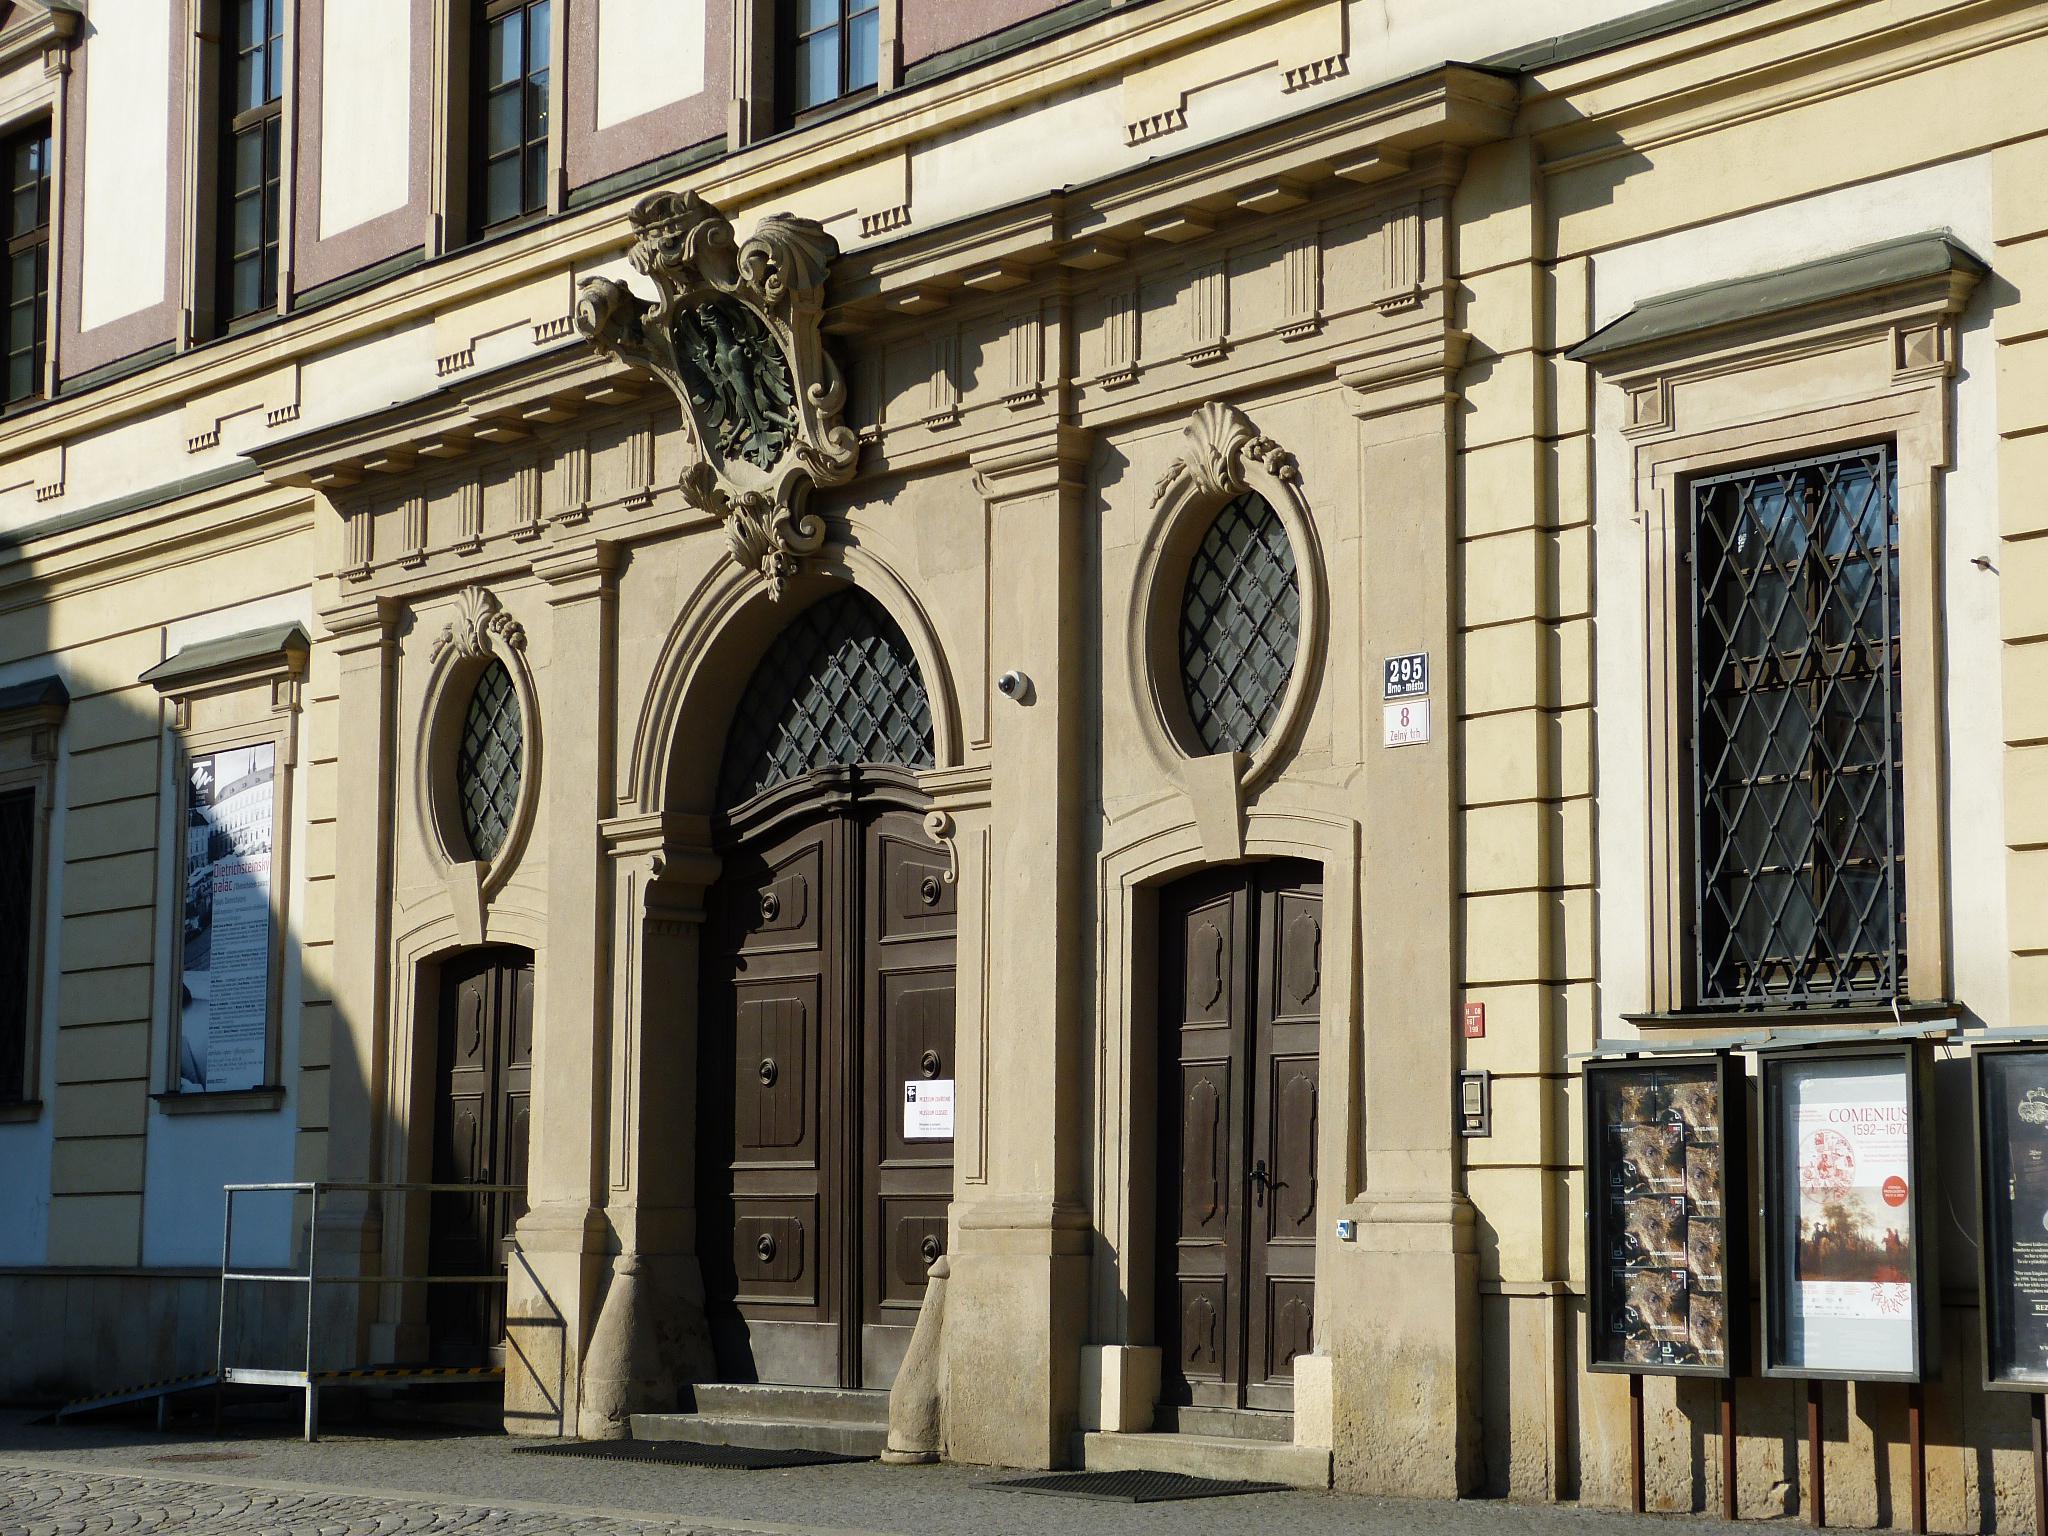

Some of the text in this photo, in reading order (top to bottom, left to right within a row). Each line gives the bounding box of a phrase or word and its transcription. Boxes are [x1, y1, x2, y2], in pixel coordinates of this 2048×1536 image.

[1389, 657, 1422, 683] 295
[1387, 682, 1402, 694] Brno
[1405, 679, 1424, 692] město
[1400, 707, 1410, 727] 8
[1390, 728, 1421, 742] Zelný trh
[1829, 1107, 1908, 1122] COMENIUS
